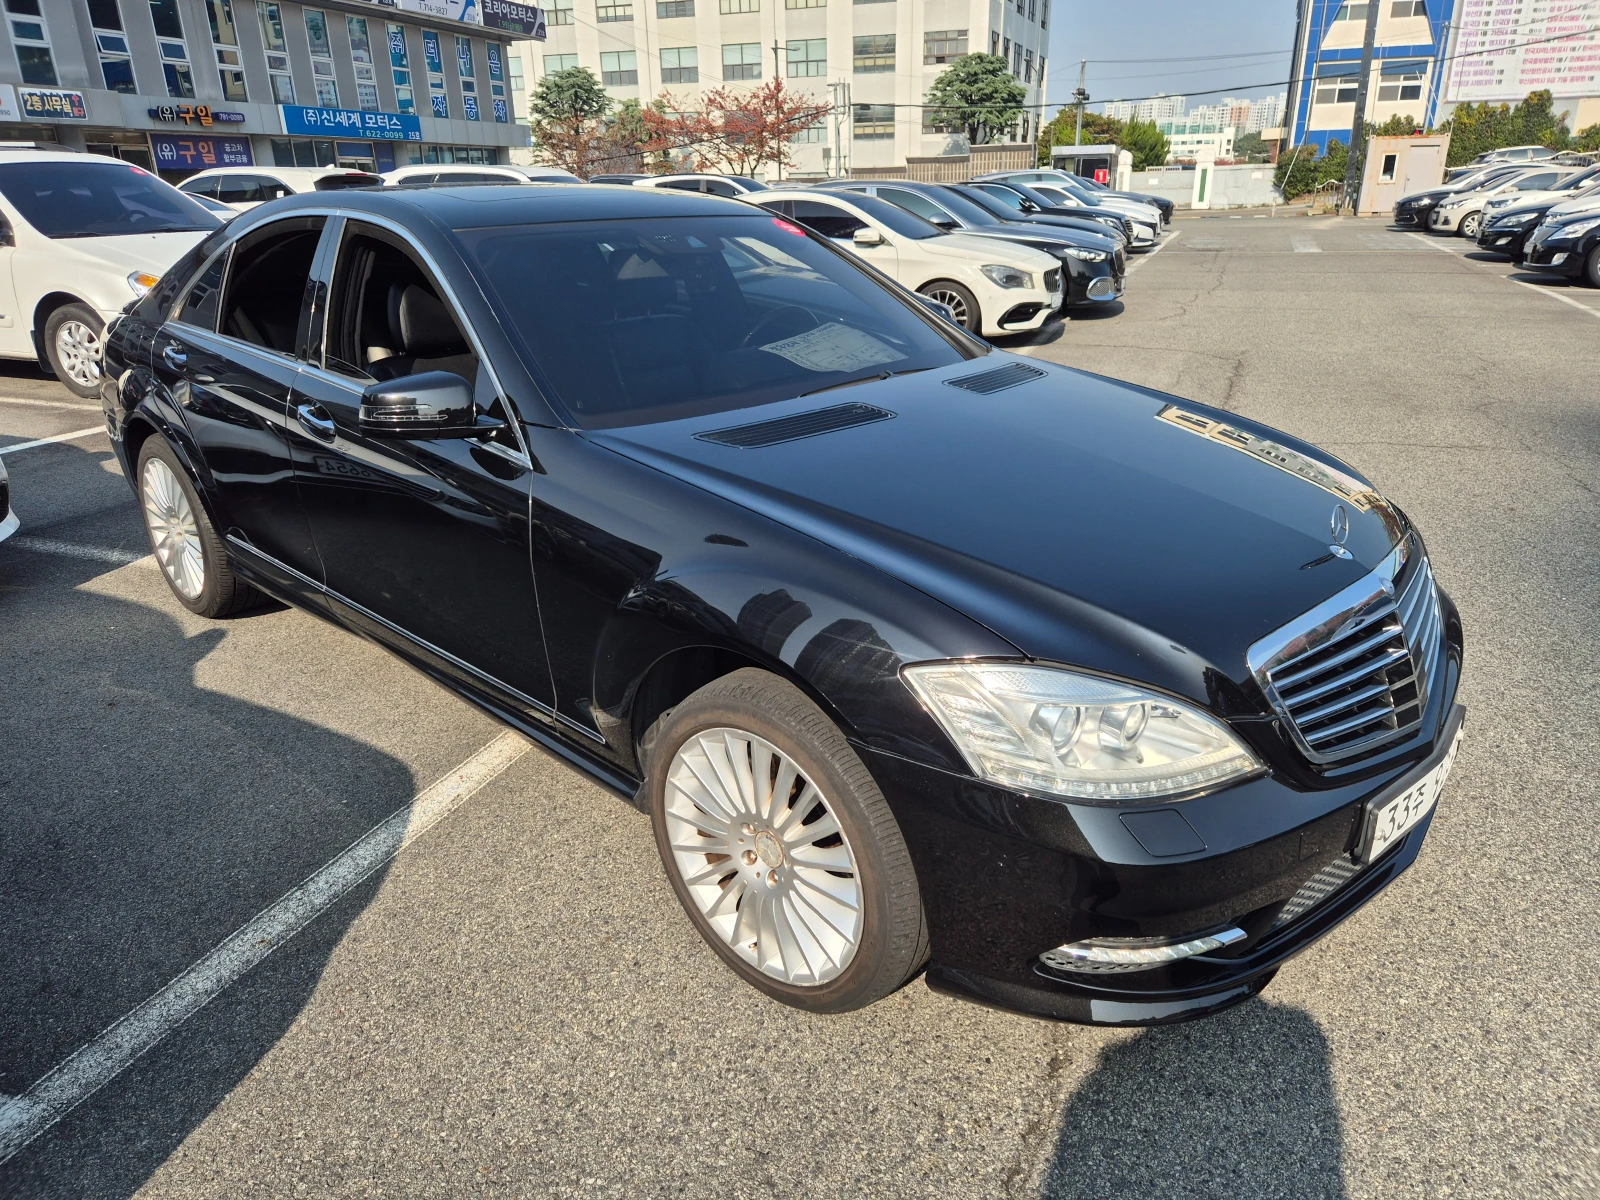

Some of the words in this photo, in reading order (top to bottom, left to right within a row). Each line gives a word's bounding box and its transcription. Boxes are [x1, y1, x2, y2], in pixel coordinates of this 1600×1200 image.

[484, 0, 535, 22] 코리아모터스
[24, 95, 43, 111] 2층
[44, 96, 72, 113] 사무실
[365, 114, 402, 129] 모터스
[224, 143, 243, 152] 중고차
[223, 154, 247, 163] 할부금융
[1098, 171, 1104, 181] 1
